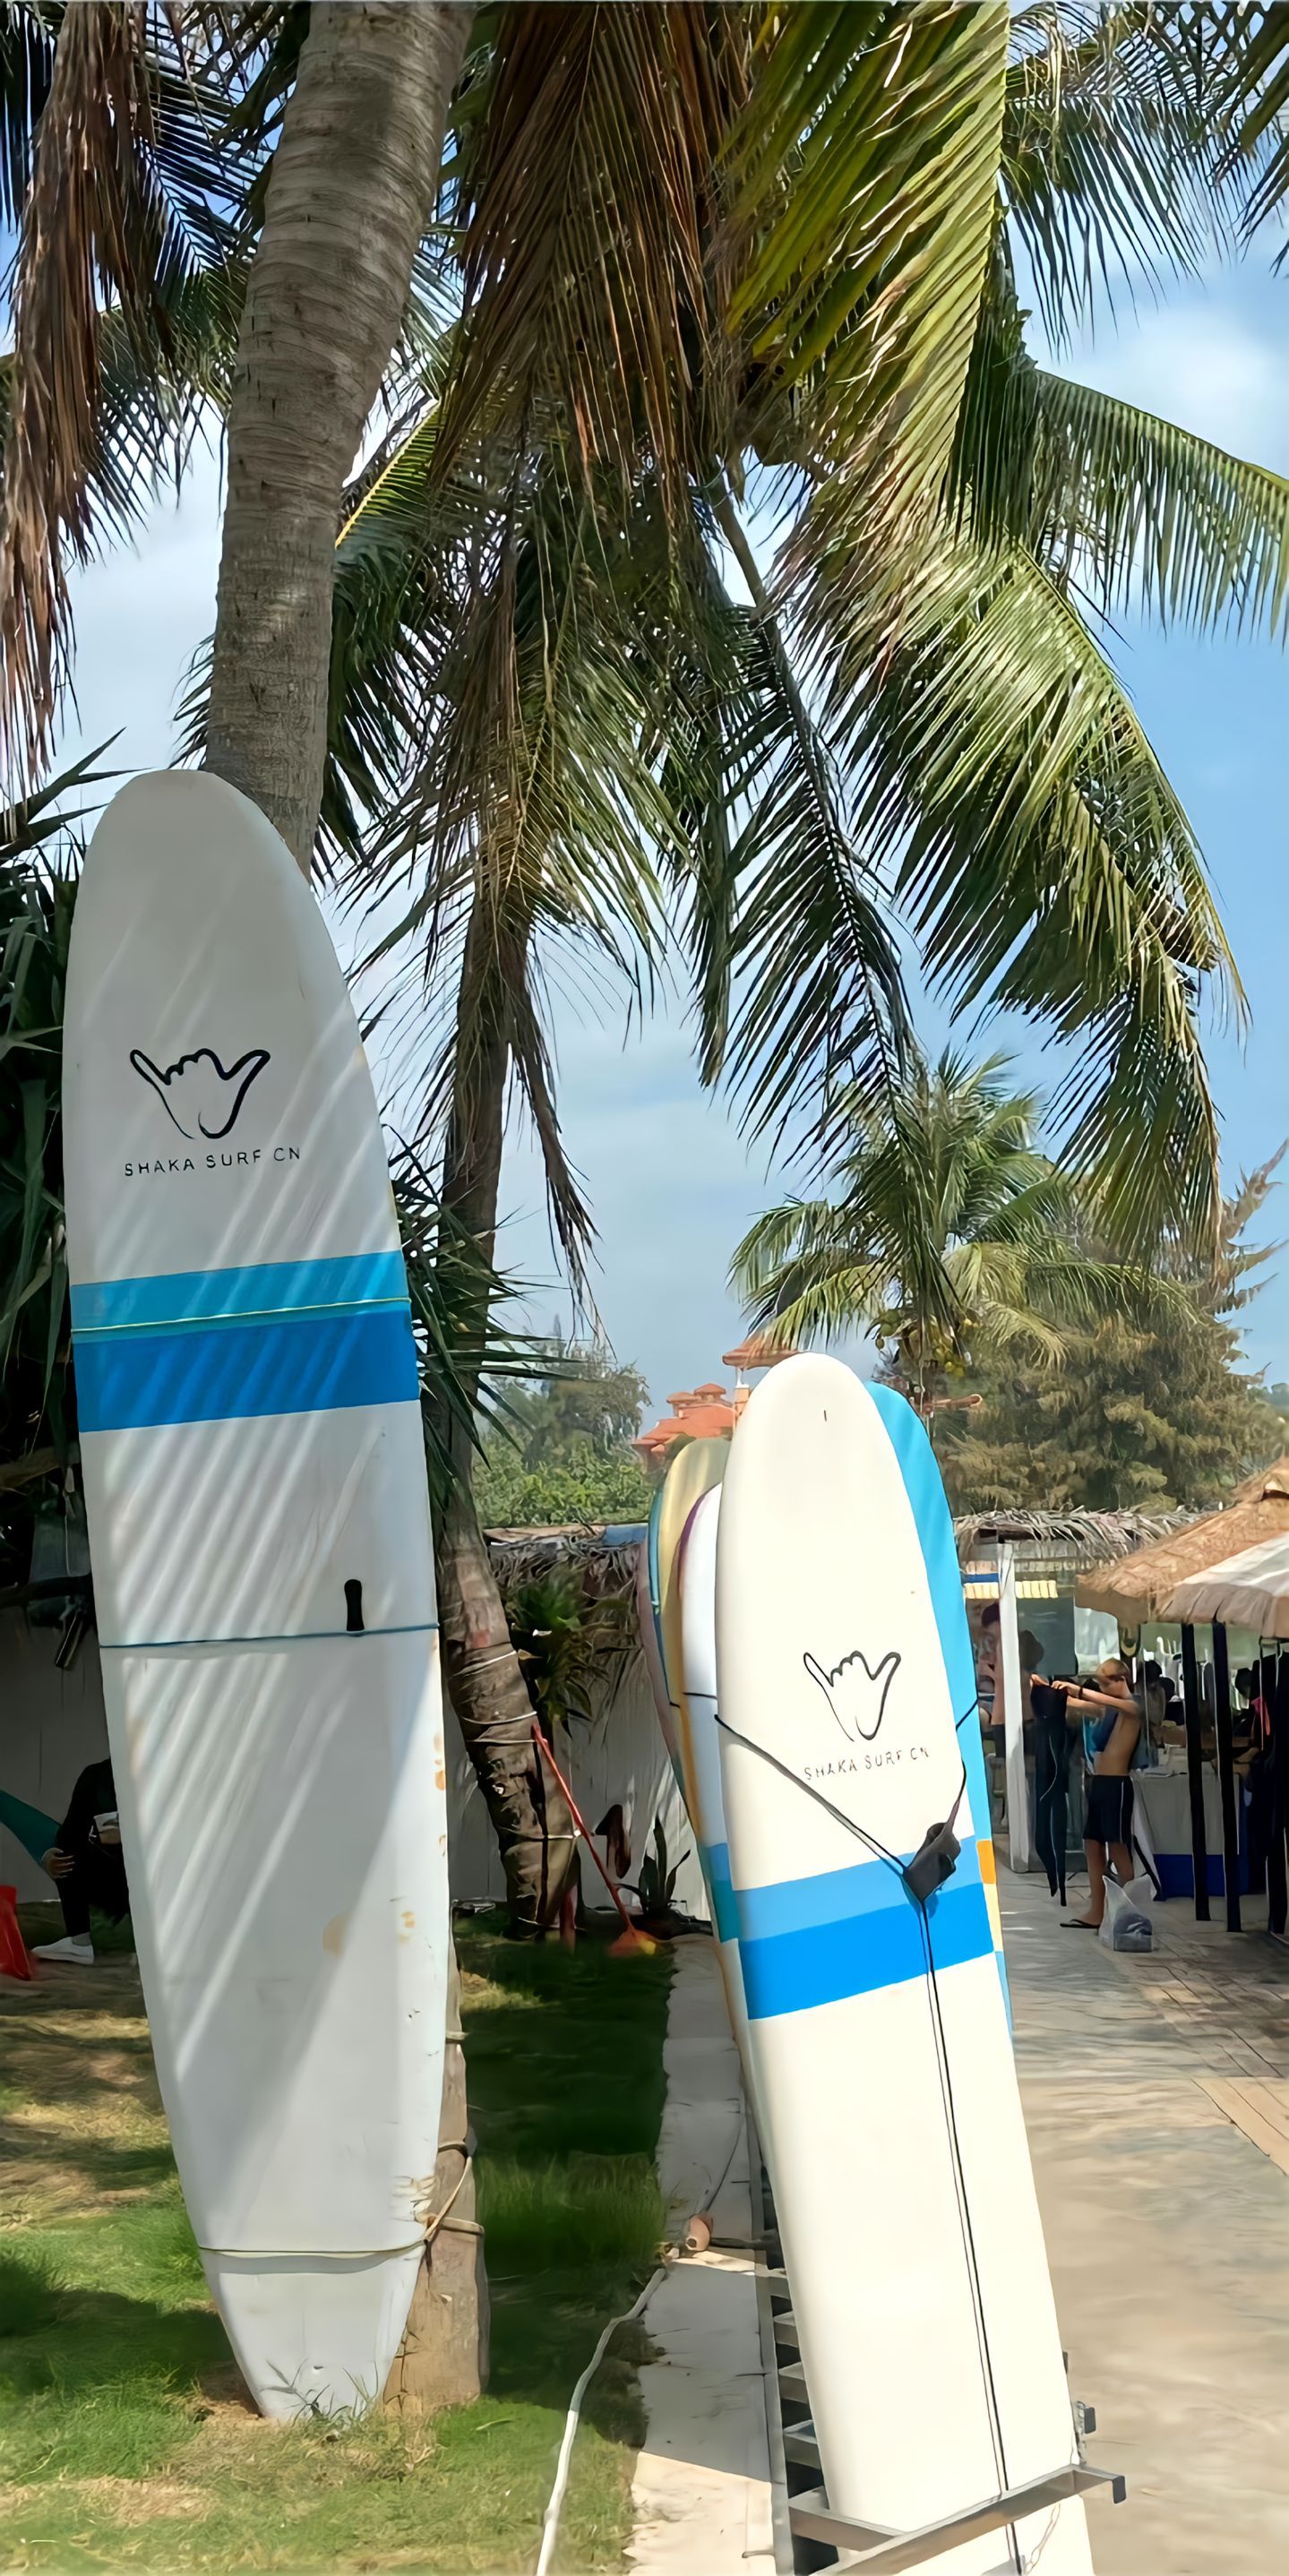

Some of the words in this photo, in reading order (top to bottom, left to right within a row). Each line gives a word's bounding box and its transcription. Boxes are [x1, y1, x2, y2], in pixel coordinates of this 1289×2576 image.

[125, 1158, 195, 1177] SHAKA
[205, 1149, 262, 1169] SURF
[272, 1146, 301, 1162] CN
[804, 1759, 858, 1781] SHAKA
[864, 1750, 902, 1770] SURF
[910, 1747, 930, 1761] CN
